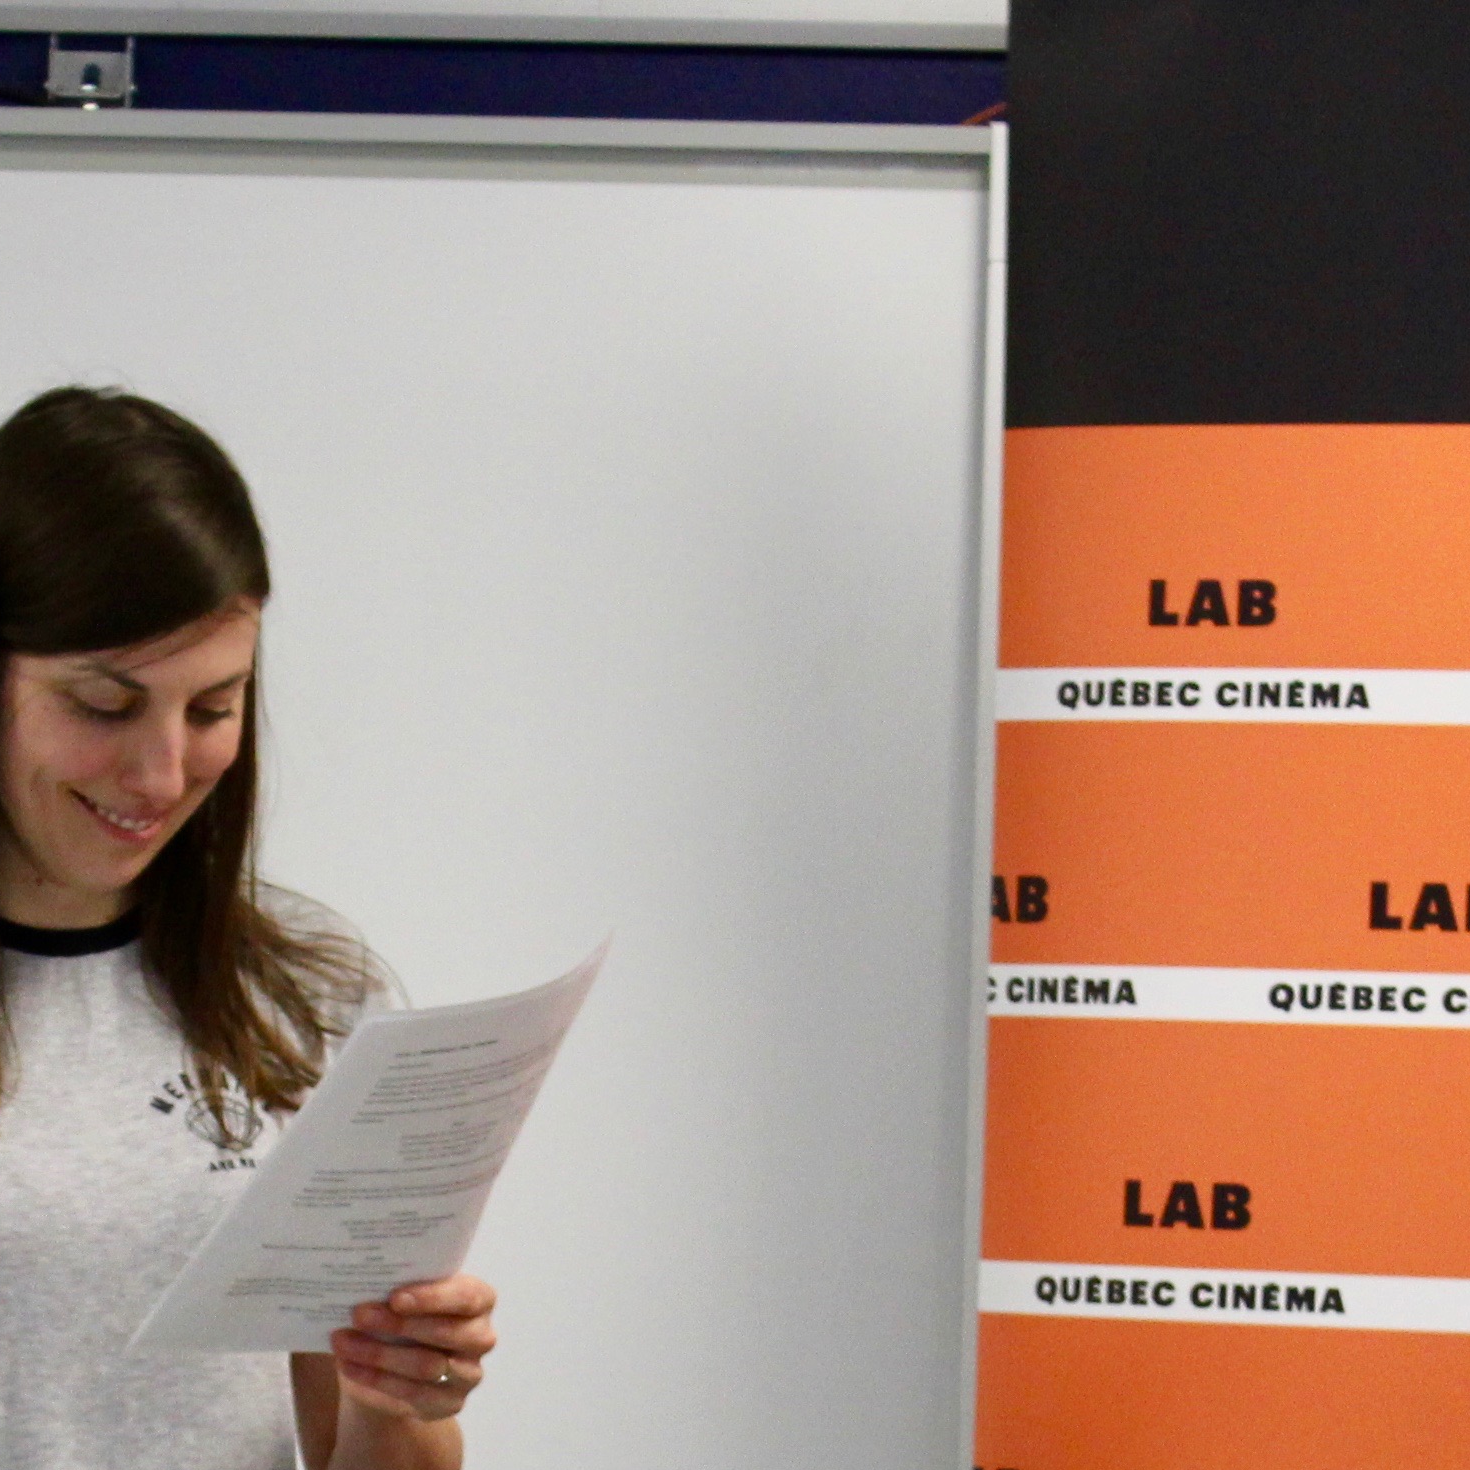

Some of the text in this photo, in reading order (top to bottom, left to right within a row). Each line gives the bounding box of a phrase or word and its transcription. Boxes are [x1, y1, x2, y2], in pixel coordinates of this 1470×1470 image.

[1148, 579, 1277, 627] LAB
[1057, 678, 1370, 710] QUÉBEC CINÉMA
[1006, 974, 1137, 1005] CINÉMA
[1269, 982, 1427, 1014] QUÉBEC
[1123, 1179, 1252, 1231] LAB
[1035, 1274, 1346, 1315] QUÉBEC CINÉMA
